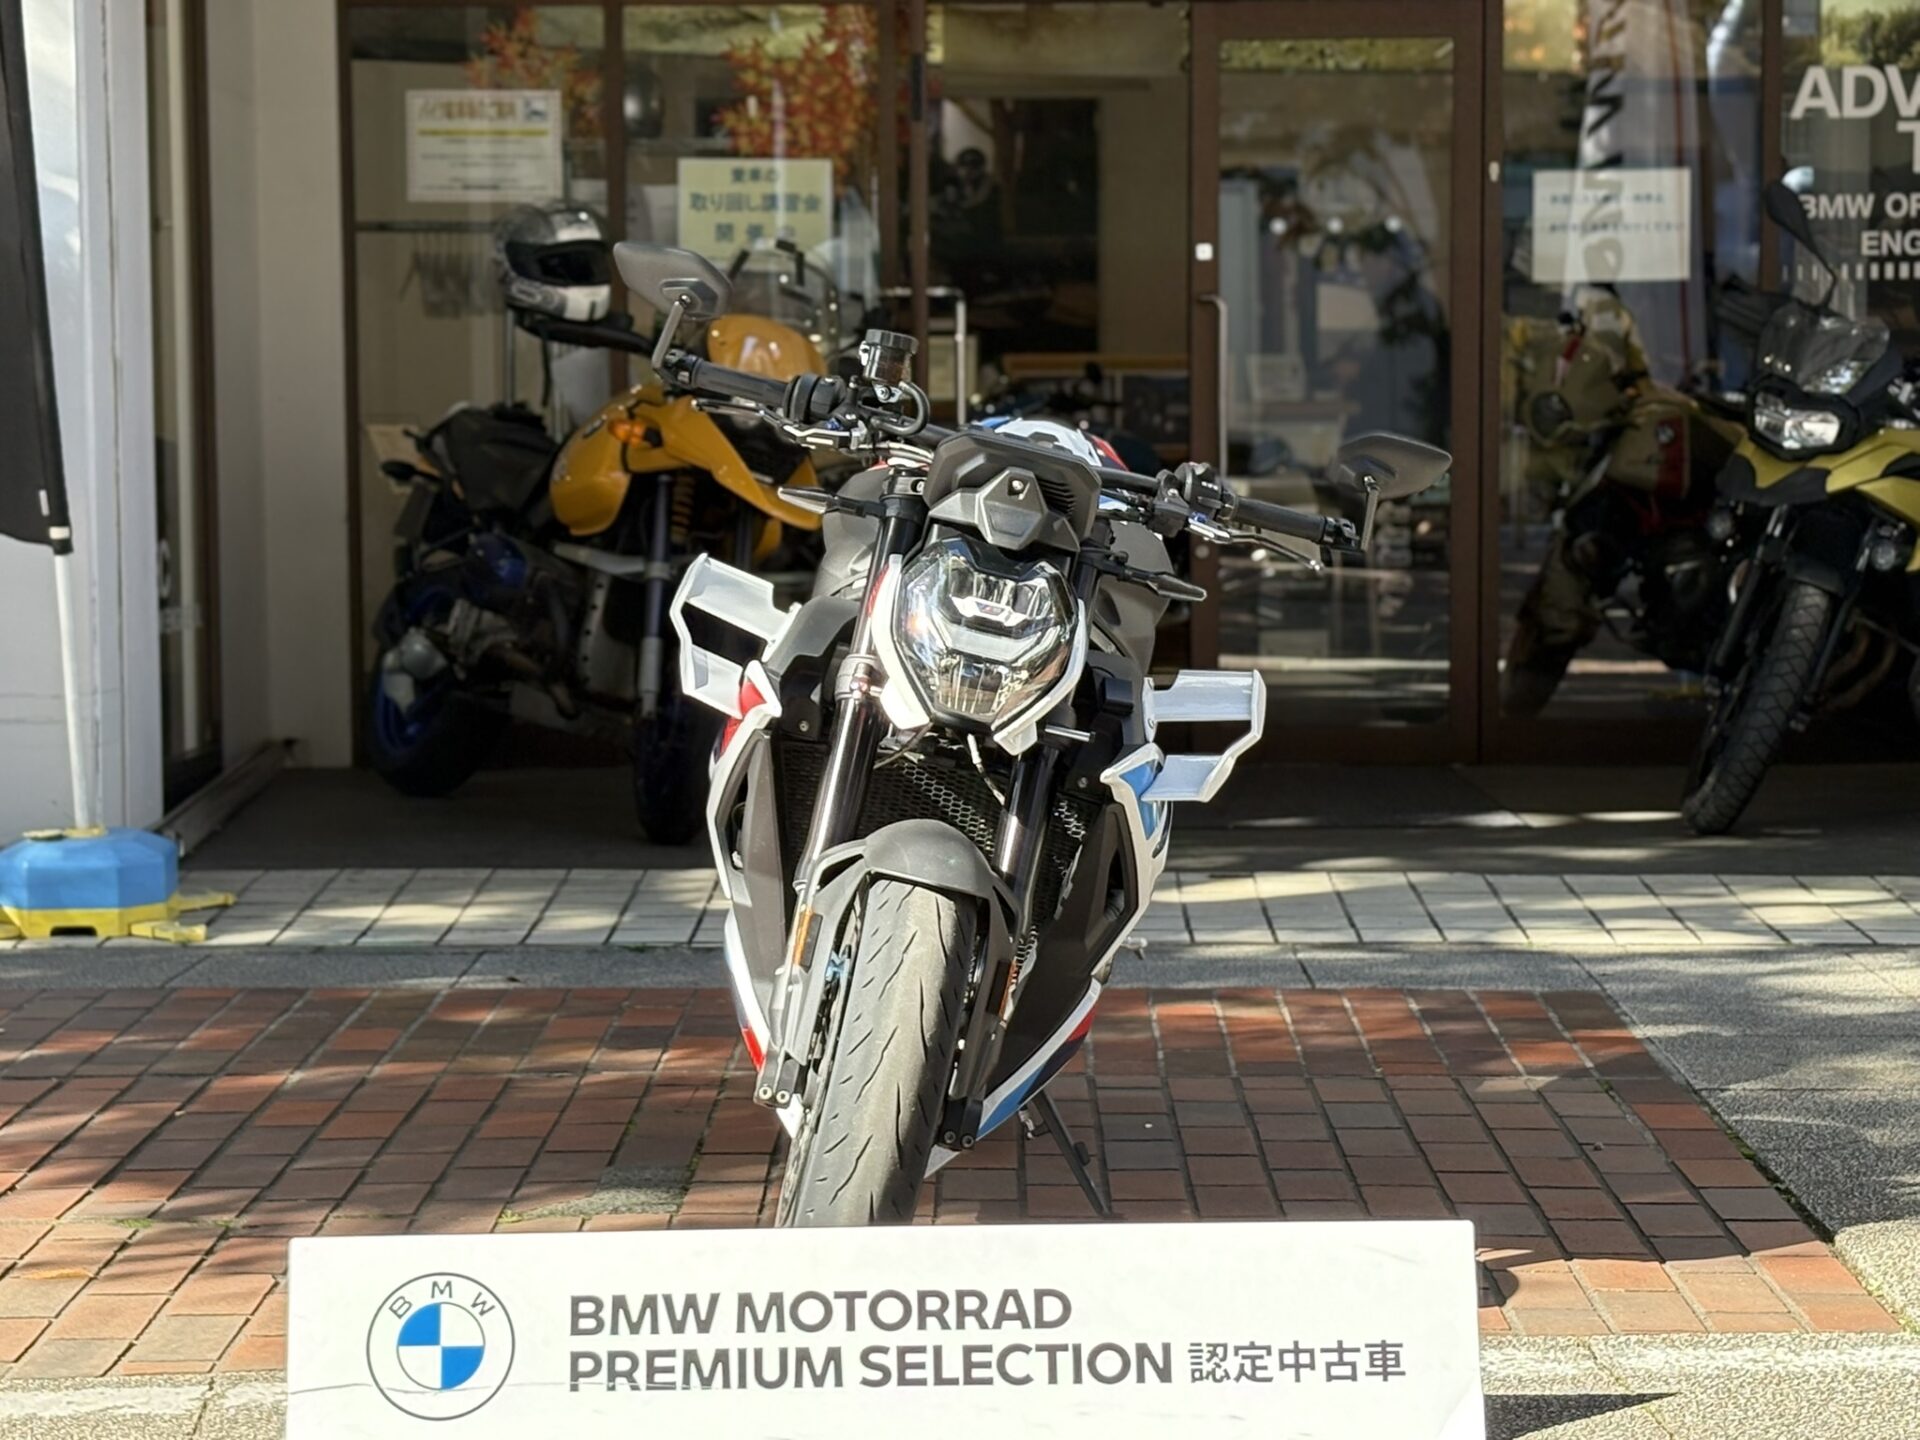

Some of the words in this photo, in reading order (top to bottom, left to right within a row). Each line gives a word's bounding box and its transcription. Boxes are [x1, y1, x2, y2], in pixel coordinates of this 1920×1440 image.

[388, 1280, 496, 1320] BMW
[570, 1292, 721, 1336] BMW
[735, 1288, 1072, 1334] MOTORRAD
[569, 1346, 844, 1392] PREMIUM
[859, 1341, 1173, 1388] SELECTION
[1187, 1339, 1406, 1384] 認定中古車
